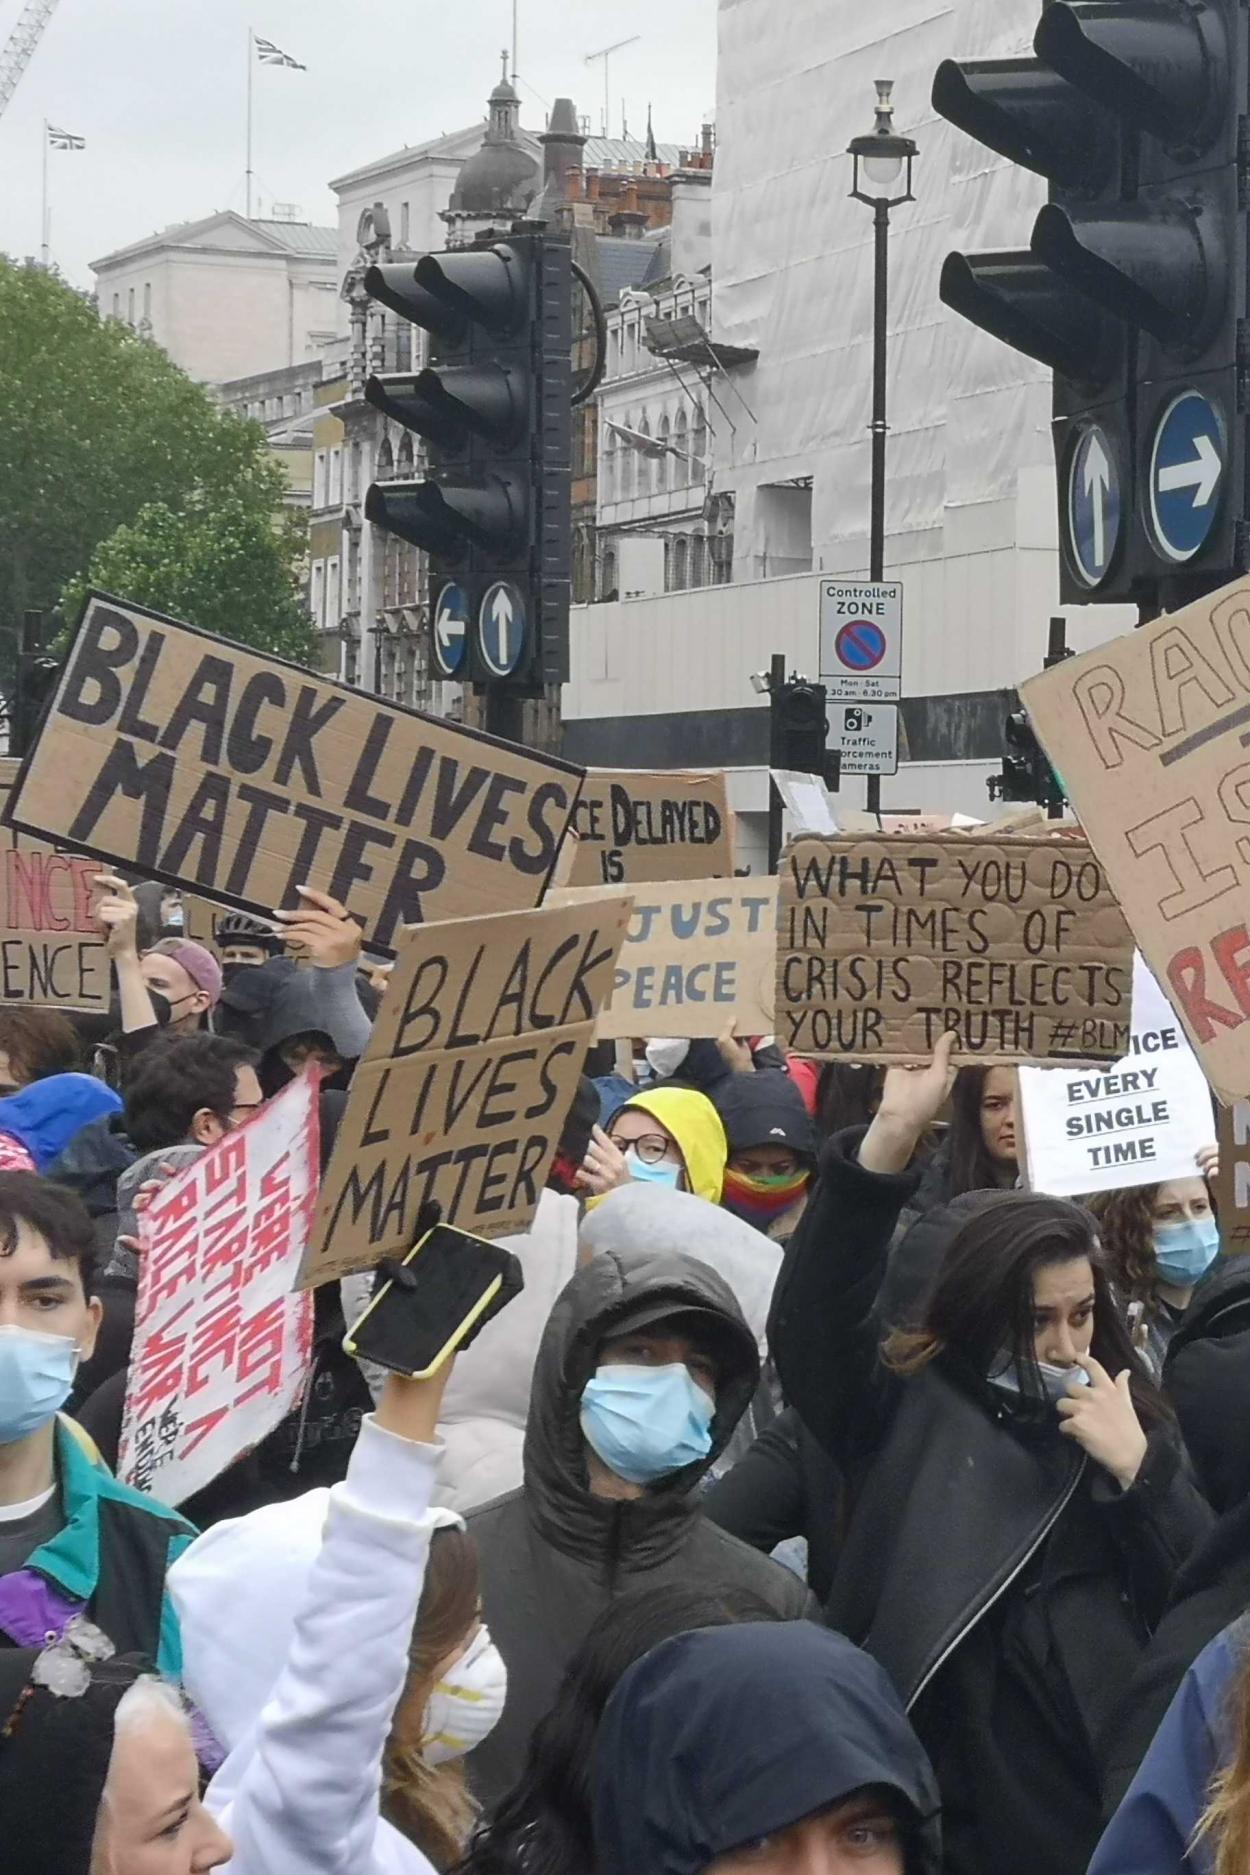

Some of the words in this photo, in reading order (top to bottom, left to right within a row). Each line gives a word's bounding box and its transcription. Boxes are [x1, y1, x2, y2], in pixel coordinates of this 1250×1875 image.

[826, 586, 897, 599] Controlled
[836, 601, 885, 616] ZONE
[57, 605, 346, 798] BLACK
[343, 715, 569, 875] LIVES
[840, 737, 876, 747] Traffic
[841, 750, 893, 760] orcement
[841, 761, 880, 771] ameras
[68, 738, 446, 925] MATTER
[610, 784, 721, 847] DELAYED
[601, 850, 625, 883] IS
[791, 855, 939, 899] WHAT
[957, 859, 1026, 901] YOU
[1050, 859, 1099, 902] DO
[788, 906, 829, 950] IN
[855, 904, 990, 954] TIMES
[1023, 908, 1077, 955] OF
[391, 929, 614, 1059] BLACK
[603, 961, 737, 1012] PEACE
[782, 957, 911, 1004] CRISIS
[942, 957, 1123, 1009] REFLECTS
[785, 1009, 884, 1050] YOUR
[916, 1006, 1036, 1053] TRUTH
[1047, 1013, 1131, 1051] #BLM
[360, 1041, 577, 1148] LIVES
[1066, 1068, 1159, 1102] EVERY
[1066, 1101, 1170, 1138] SINGLE
[1087, 1138, 1156, 1168] TIME
[320, 1135, 551, 1253] MATTER
[234, 1297, 287, 1409] NOT
[180, 1404, 229, 1461] A
